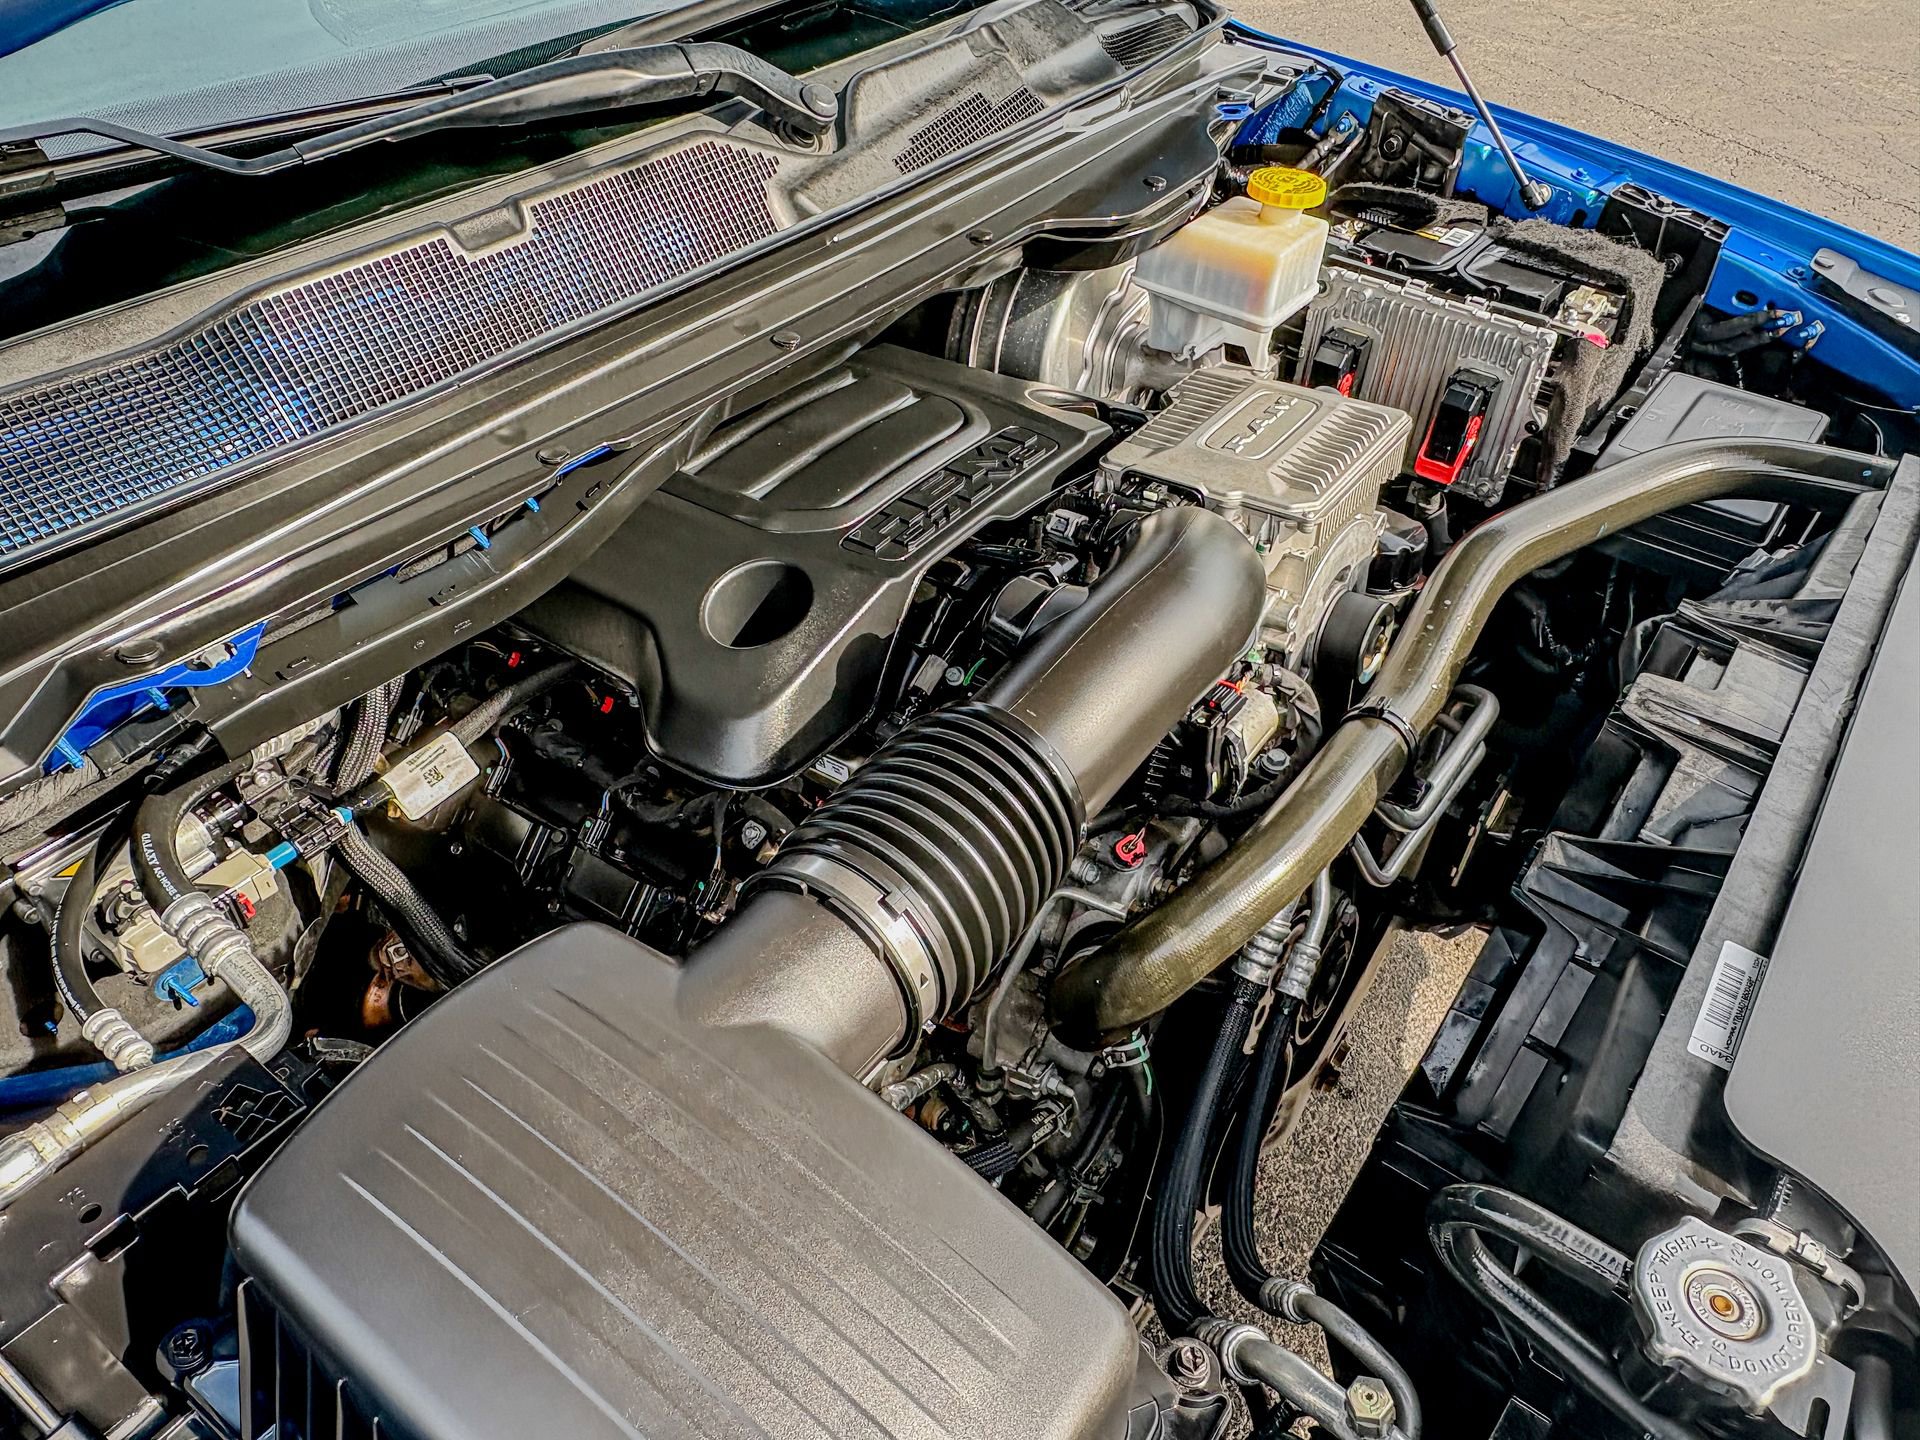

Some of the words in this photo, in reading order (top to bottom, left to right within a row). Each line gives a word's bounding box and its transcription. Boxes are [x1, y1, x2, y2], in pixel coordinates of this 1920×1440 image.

[1221, 396, 1298, 454] RAM
[846, 427, 1040, 551] HEMI
[141, 833, 158, 866] GALAXY
[1653, 1234, 1699, 1266] TIGHT
[1748, 1259, 1785, 1294] HOT
[1650, 1270, 1682, 1330] KEEP
[1781, 1296, 1804, 1349] OPEN
[1729, 1356, 1759, 1374] DO
[1761, 1345, 1793, 1373] NOT
